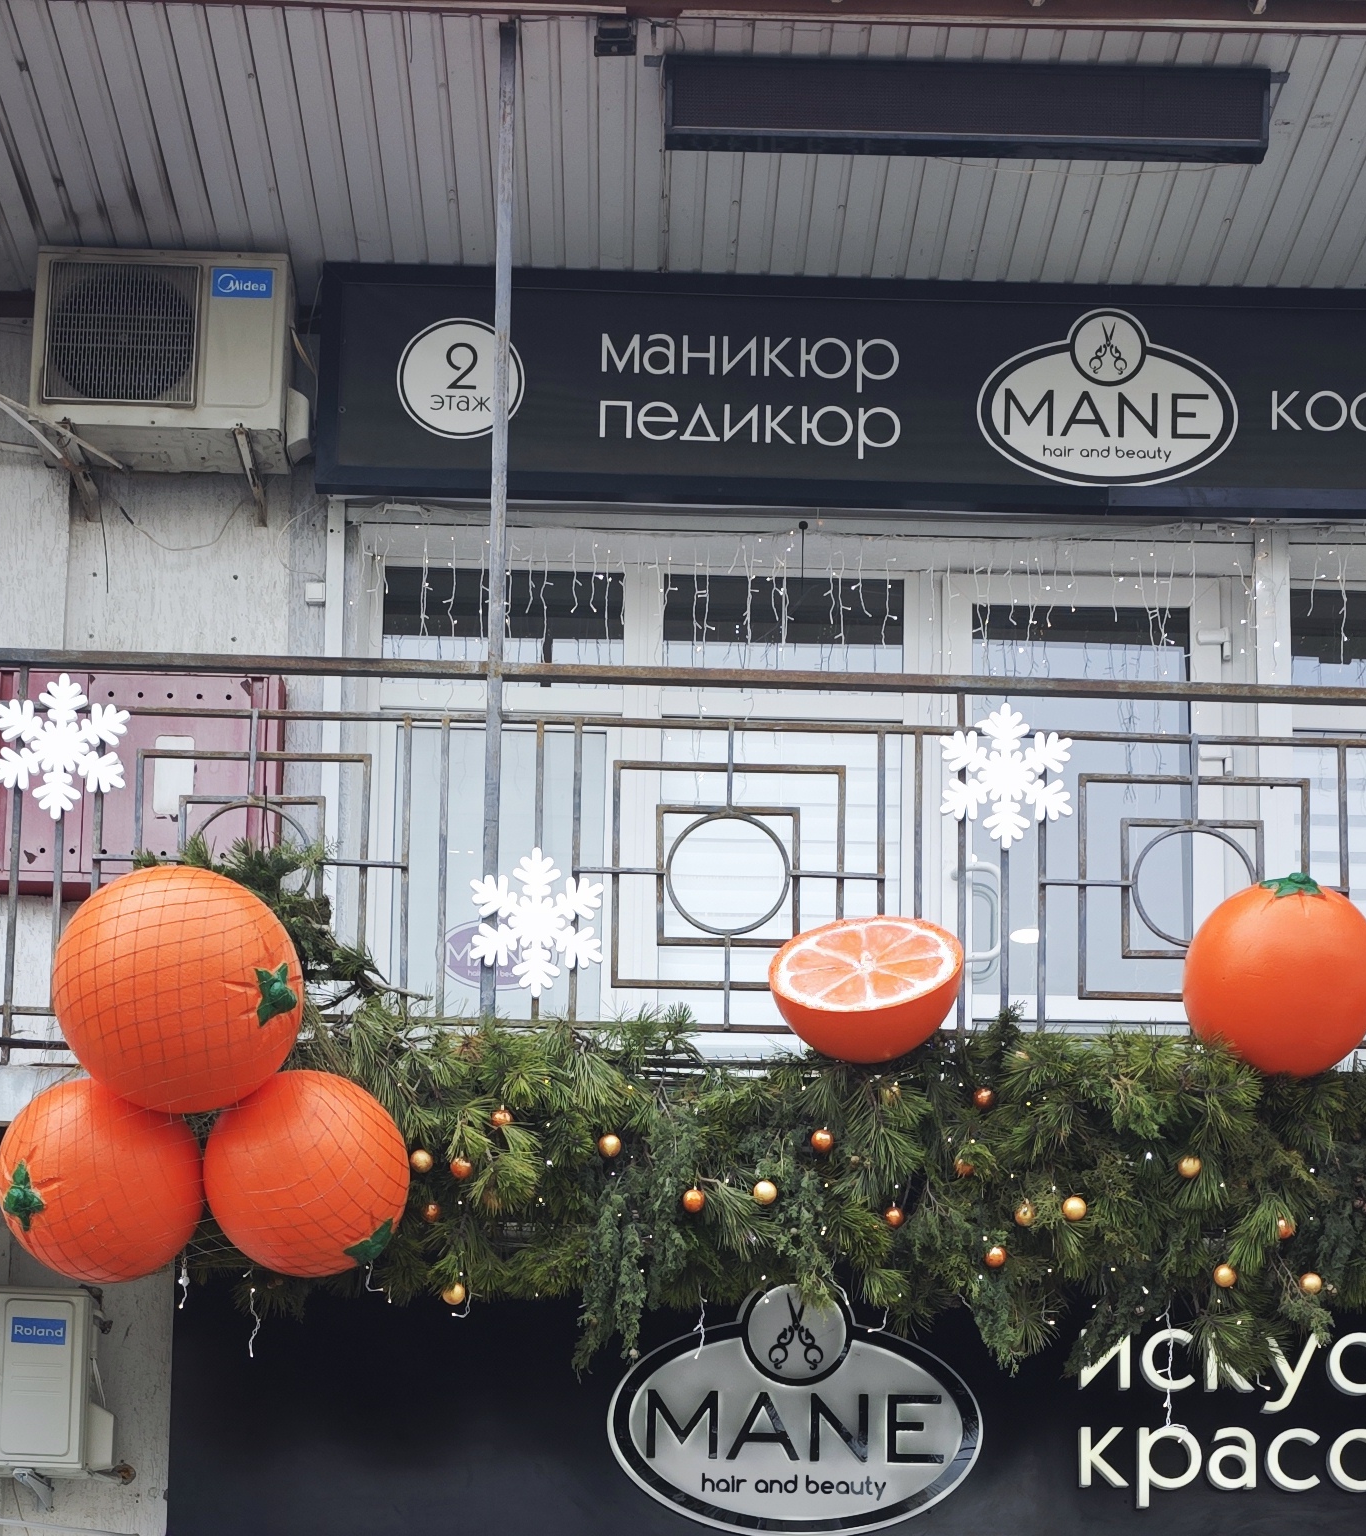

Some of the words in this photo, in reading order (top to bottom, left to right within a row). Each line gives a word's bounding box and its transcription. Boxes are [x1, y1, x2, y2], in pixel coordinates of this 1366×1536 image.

[217, 272, 267, 294] Midea
[445, 343, 479, 391] 2
[600, 332, 900, 392] маникюр
[430, 394, 492, 413] этаж
[1003, 388, 1211, 440] MANE
[599, 400, 901, 459] педикюр
[1042, 444, 1074, 459] hair
[1079, 445, 1110, 459] and
[1115, 446, 1173, 464] beauty
[15, 1325, 64, 1337] Roland
[645, 1388, 945, 1464] MANE
[701, 1473, 747, 1493] hair
[754, 1474, 798, 1494] and
[805, 1475, 887, 1501] beauty
